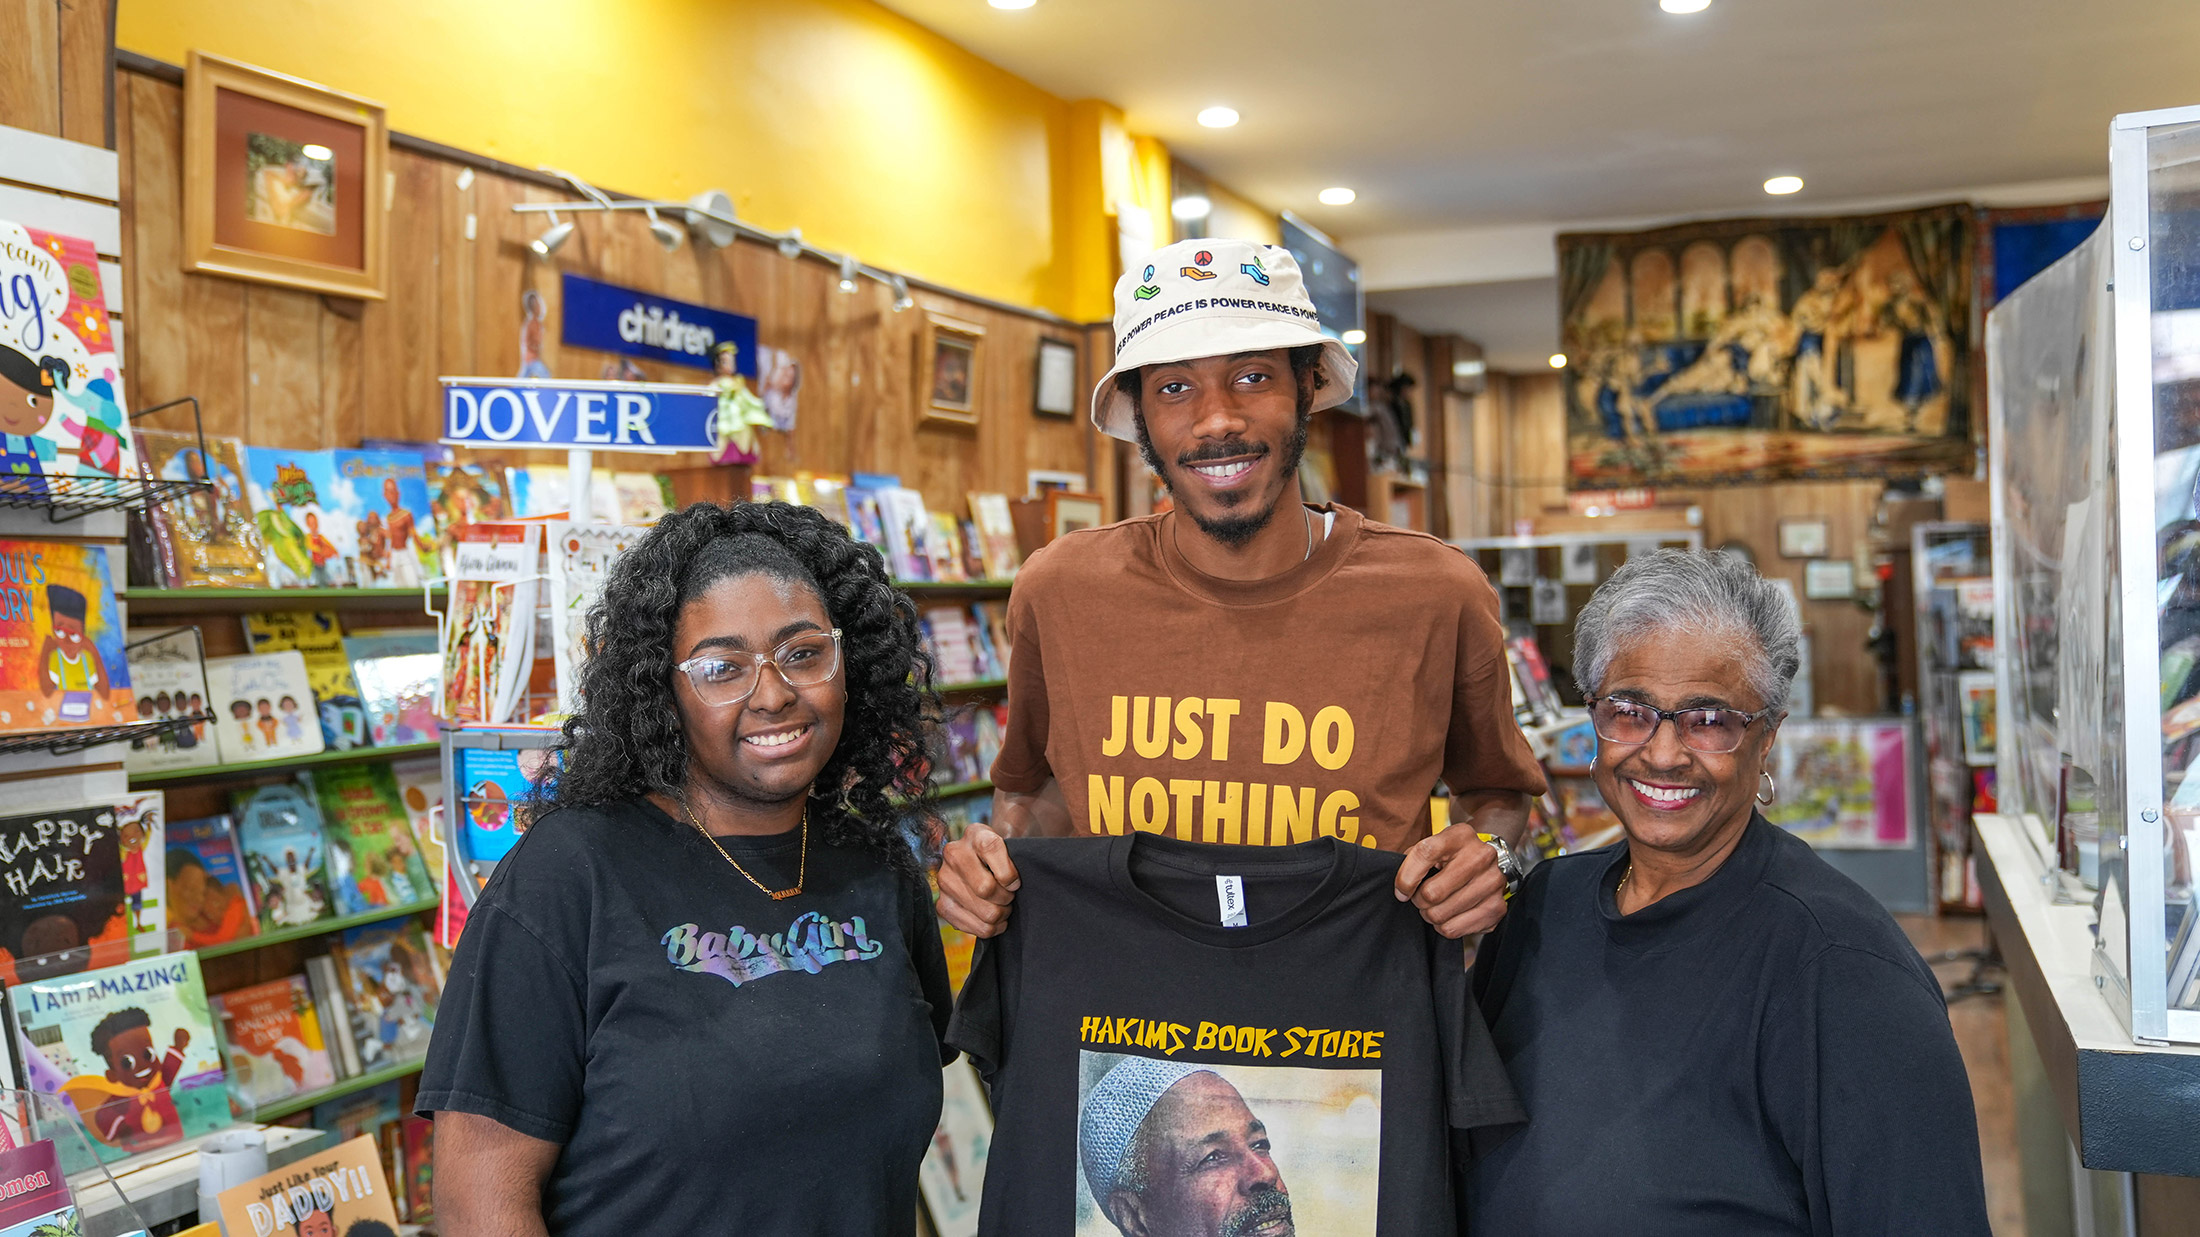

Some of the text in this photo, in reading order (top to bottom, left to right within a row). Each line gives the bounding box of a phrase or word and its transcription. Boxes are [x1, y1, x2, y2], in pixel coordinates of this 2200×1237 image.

[618, 302, 715, 356] children
[1126, 316, 1152, 343] POWER
[1153, 300, 1193, 323] PEACE
[1195, 298, 1208, 309] IS
[1211, 297, 1257, 310] POWER
[1257, 301, 1292, 315] PEACE
[1290, 306, 1300, 318] IS
[449, 388, 657, 445] DOVER
[1102, 695, 1355, 771] JUST DO
[1088, 774, 1378, 849] NOTHING.
[4, 853, 85, 896] HAIR
[1225, 884, 1235, 910] tultex
[31, 993, 40, 1013] I
[87, 963, 188, 1001] AMAZING!
[1080, 1016, 1384, 1058] HAKIMS BOOK STORE
[246, 1165, 373, 1237] DADDY!!
[259, 1160, 340, 1200] Just Like Your
